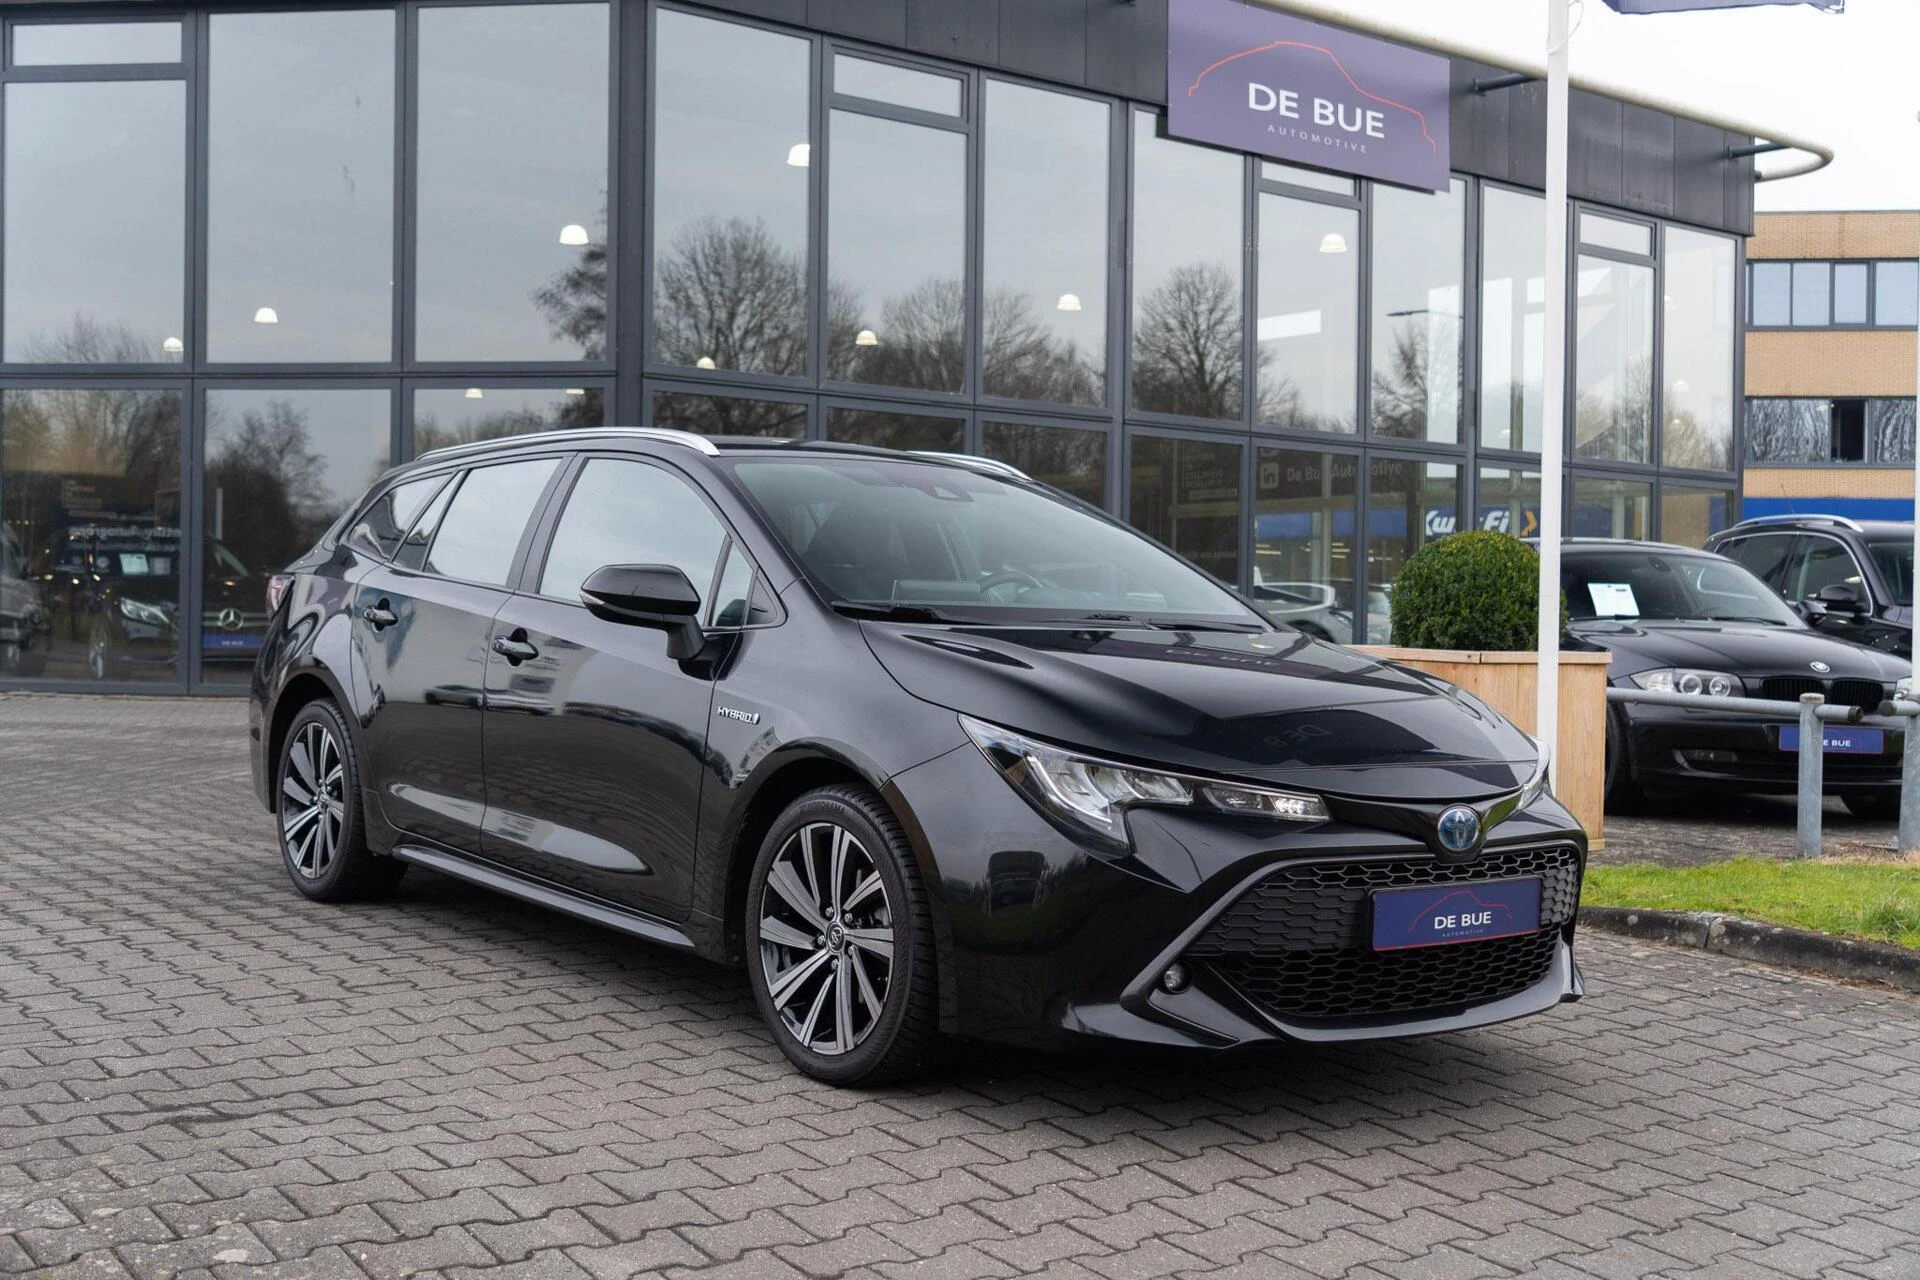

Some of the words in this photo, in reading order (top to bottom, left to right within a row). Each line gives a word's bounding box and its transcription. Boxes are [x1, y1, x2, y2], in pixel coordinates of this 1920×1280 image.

[1248, 82, 1299, 120] DE
[1313, 97, 1385, 139] BUE
[1266, 123, 1368, 154] AUTOMOTIVE
[717, 706, 752, 724] HYBRID
[1434, 914, 1457, 930] DE
[1461, 911, 1493, 927] BUE
